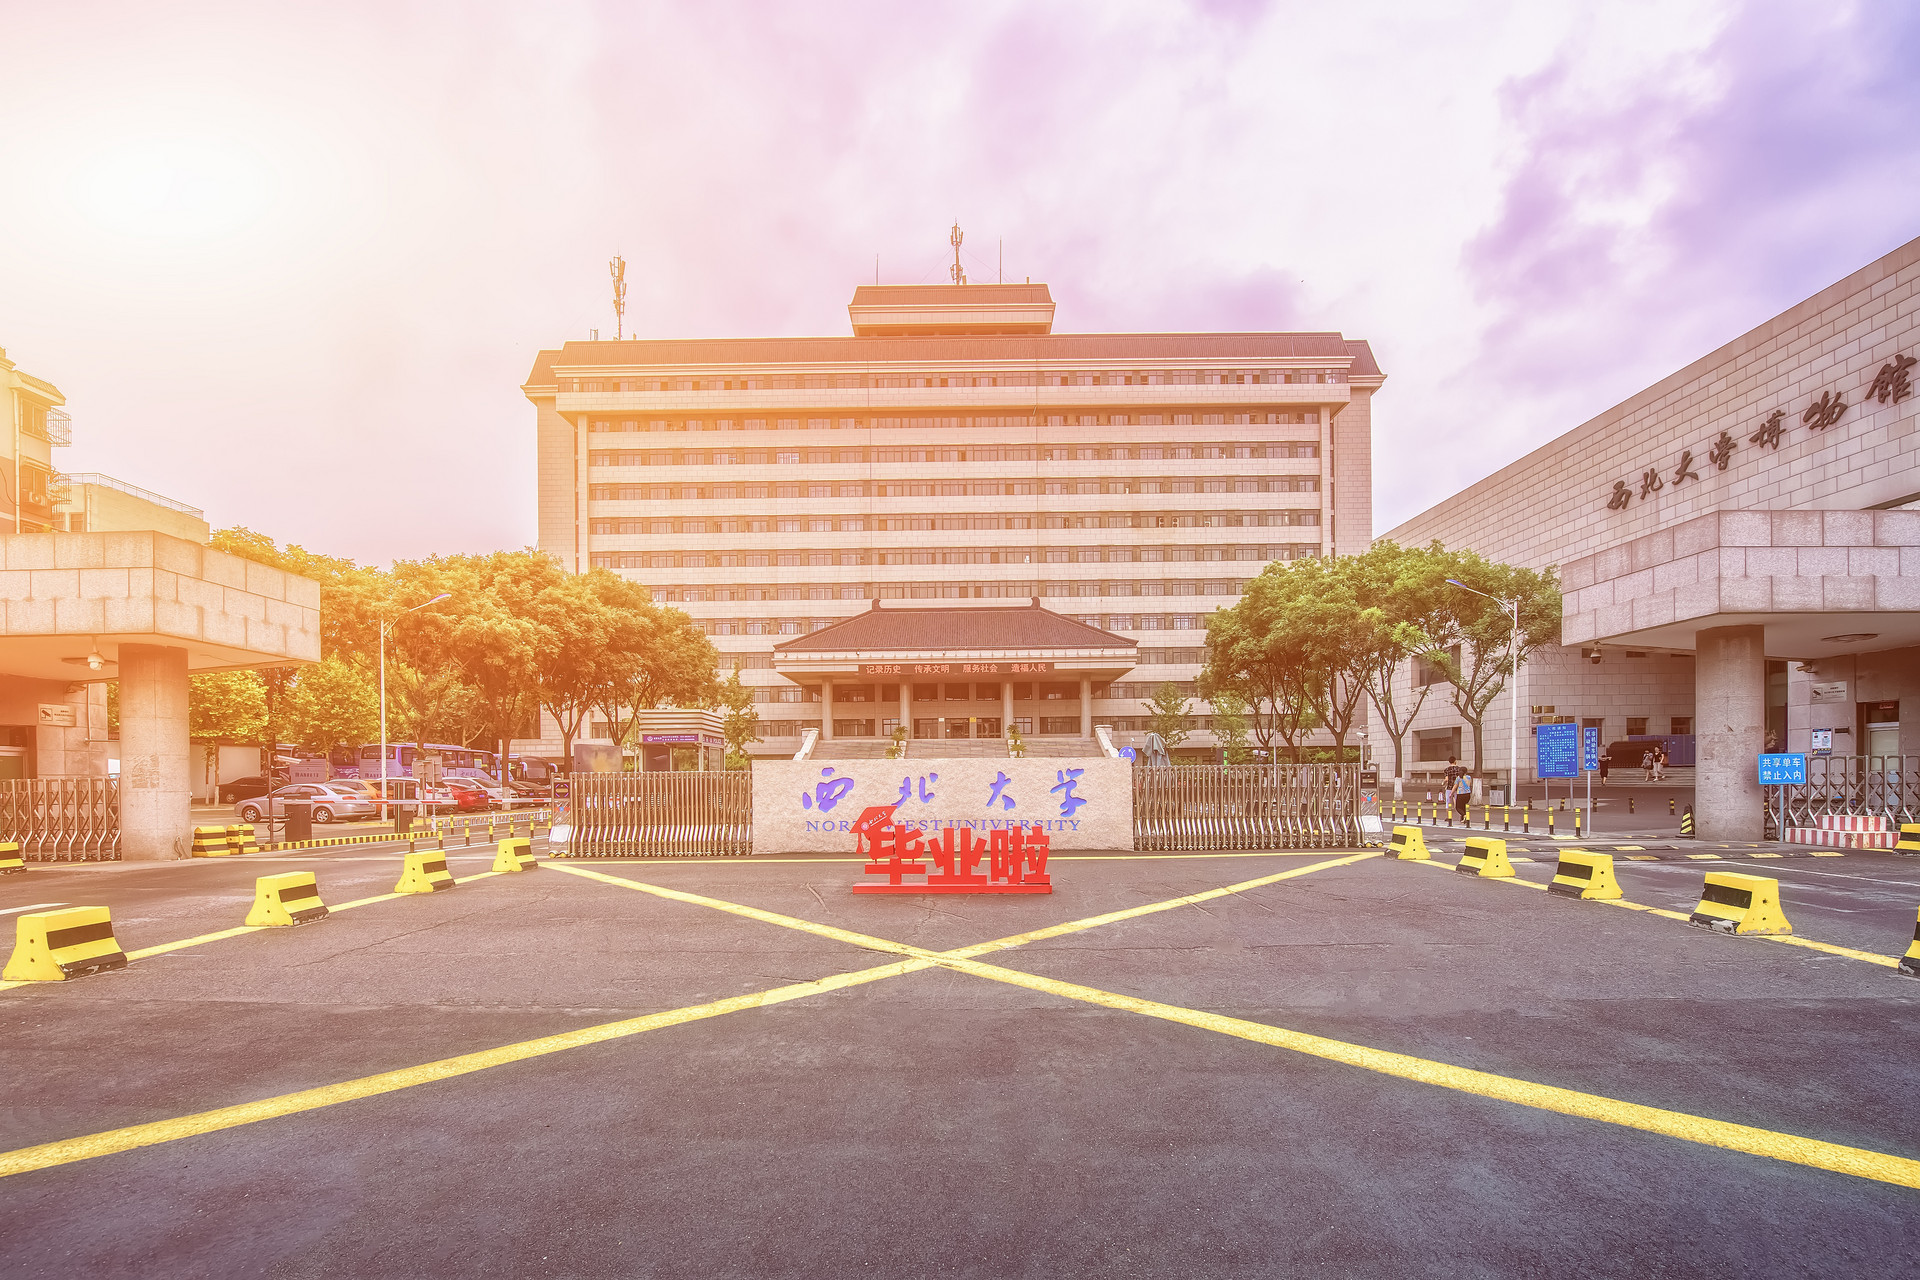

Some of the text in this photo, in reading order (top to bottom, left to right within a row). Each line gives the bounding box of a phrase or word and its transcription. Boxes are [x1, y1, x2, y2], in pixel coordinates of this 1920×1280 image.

[865, 663, 1046, 674] 记录历史 传承文明 服务社会 造福人民
[1762, 757, 1801, 767] 共享单车
[1762, 770, 1802, 780] 禁止入内
[802, 767, 1087, 817] 西北大学
[805, 820, 1080, 832] NOREST UNIVERSITY
[864, 824, 1050, 885] 毕业啦
